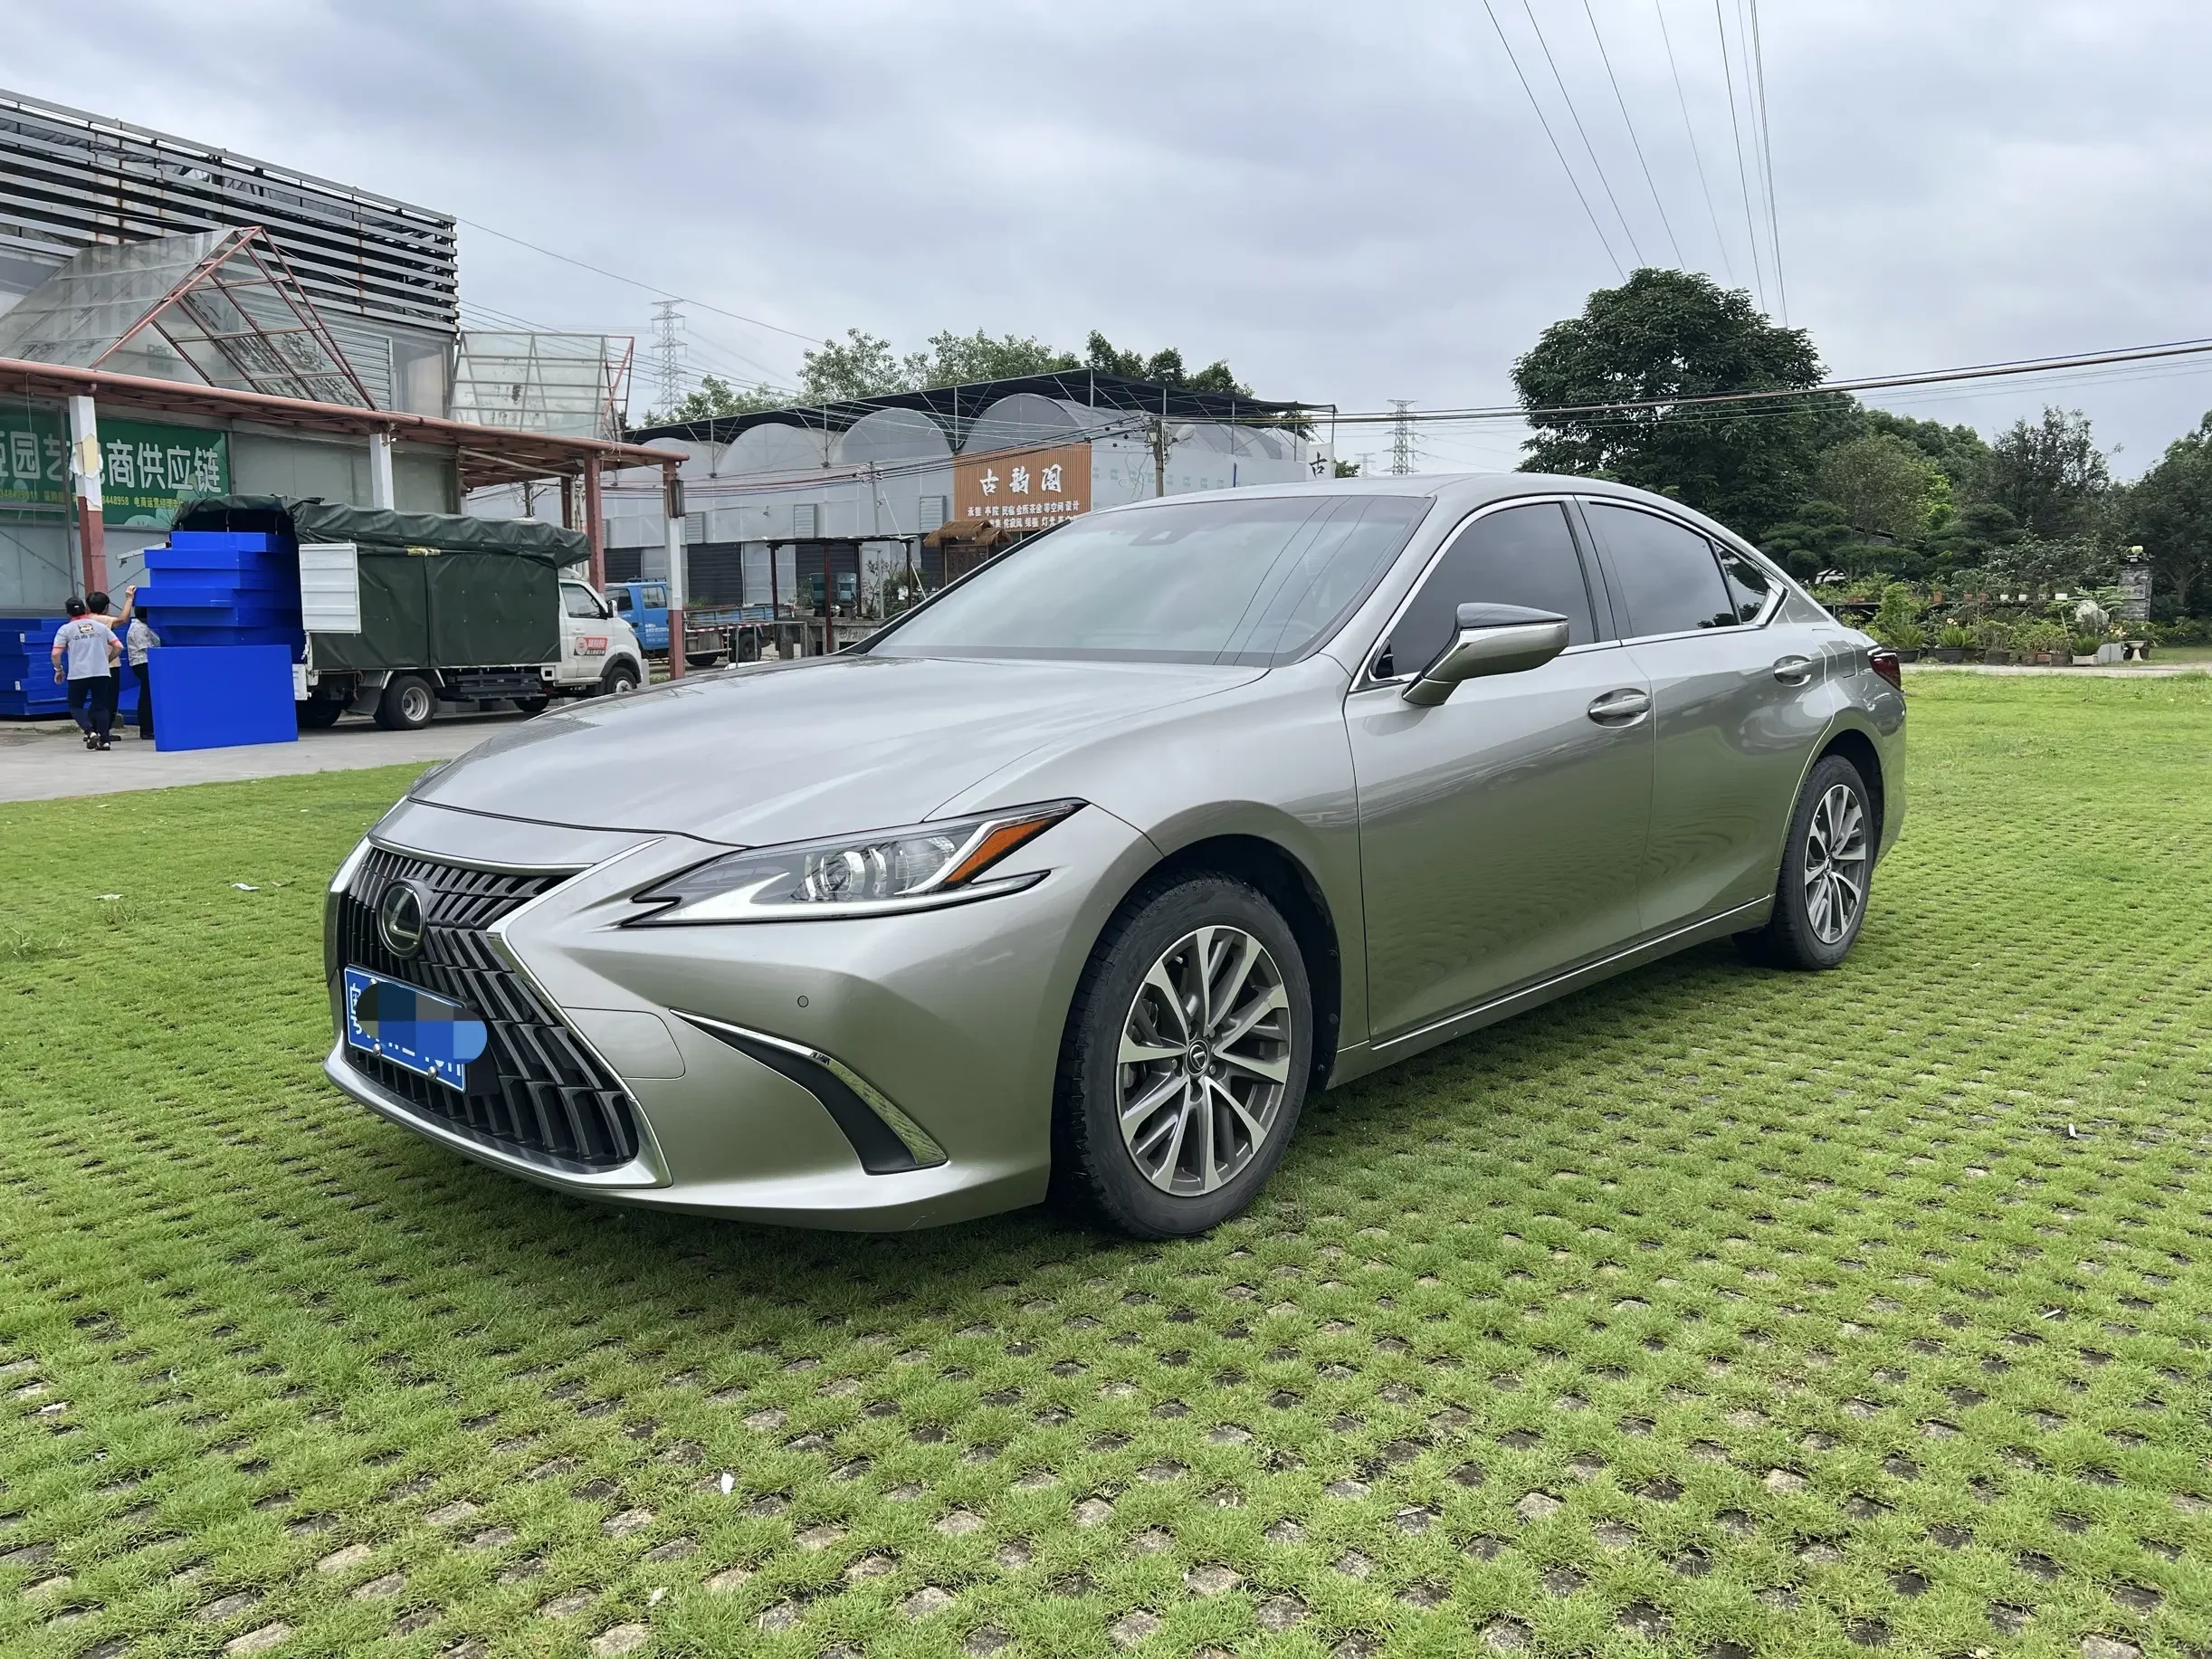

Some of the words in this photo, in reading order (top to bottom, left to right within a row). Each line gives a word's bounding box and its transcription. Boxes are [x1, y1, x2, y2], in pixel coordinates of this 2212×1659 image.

[0, 430, 222, 493] 园艺商供应链
[1309, 451, 1329, 479] 古
[979, 463, 1063, 497] 古韵阁
